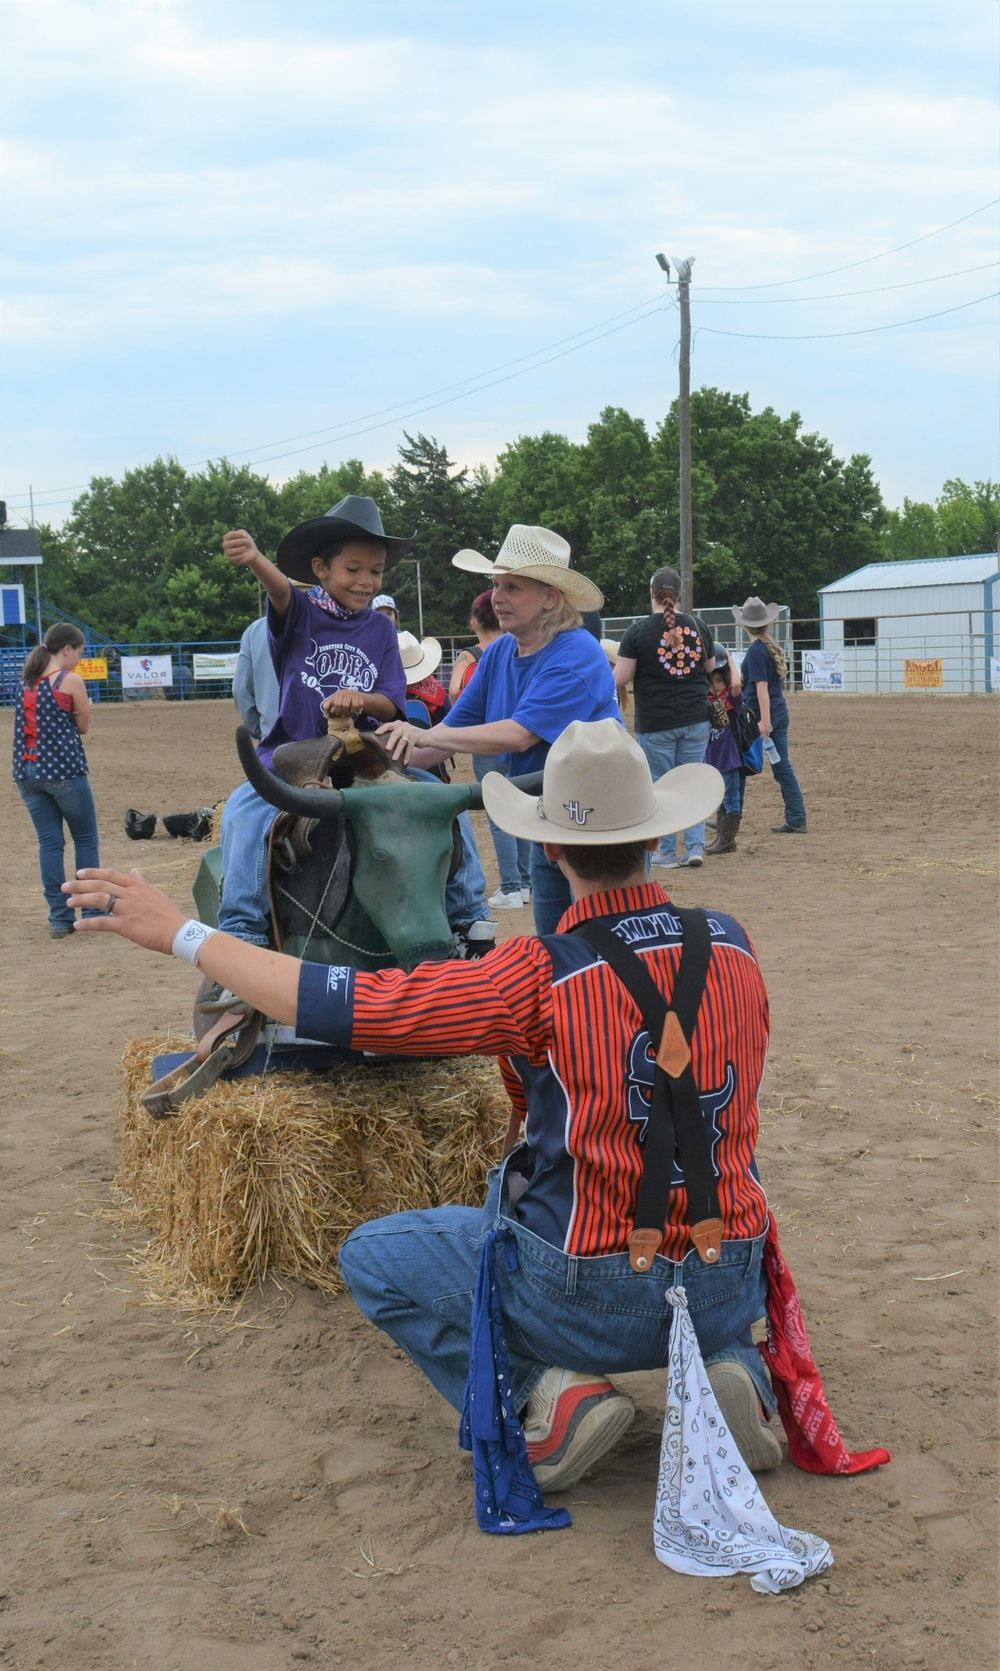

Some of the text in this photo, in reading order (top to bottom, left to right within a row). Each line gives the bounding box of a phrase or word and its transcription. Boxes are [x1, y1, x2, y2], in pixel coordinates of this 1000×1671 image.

[905, 659, 942, 672] ENGEL
[127, 671, 167, 679] VALOR
[793, 1380, 815, 1421] INCH
